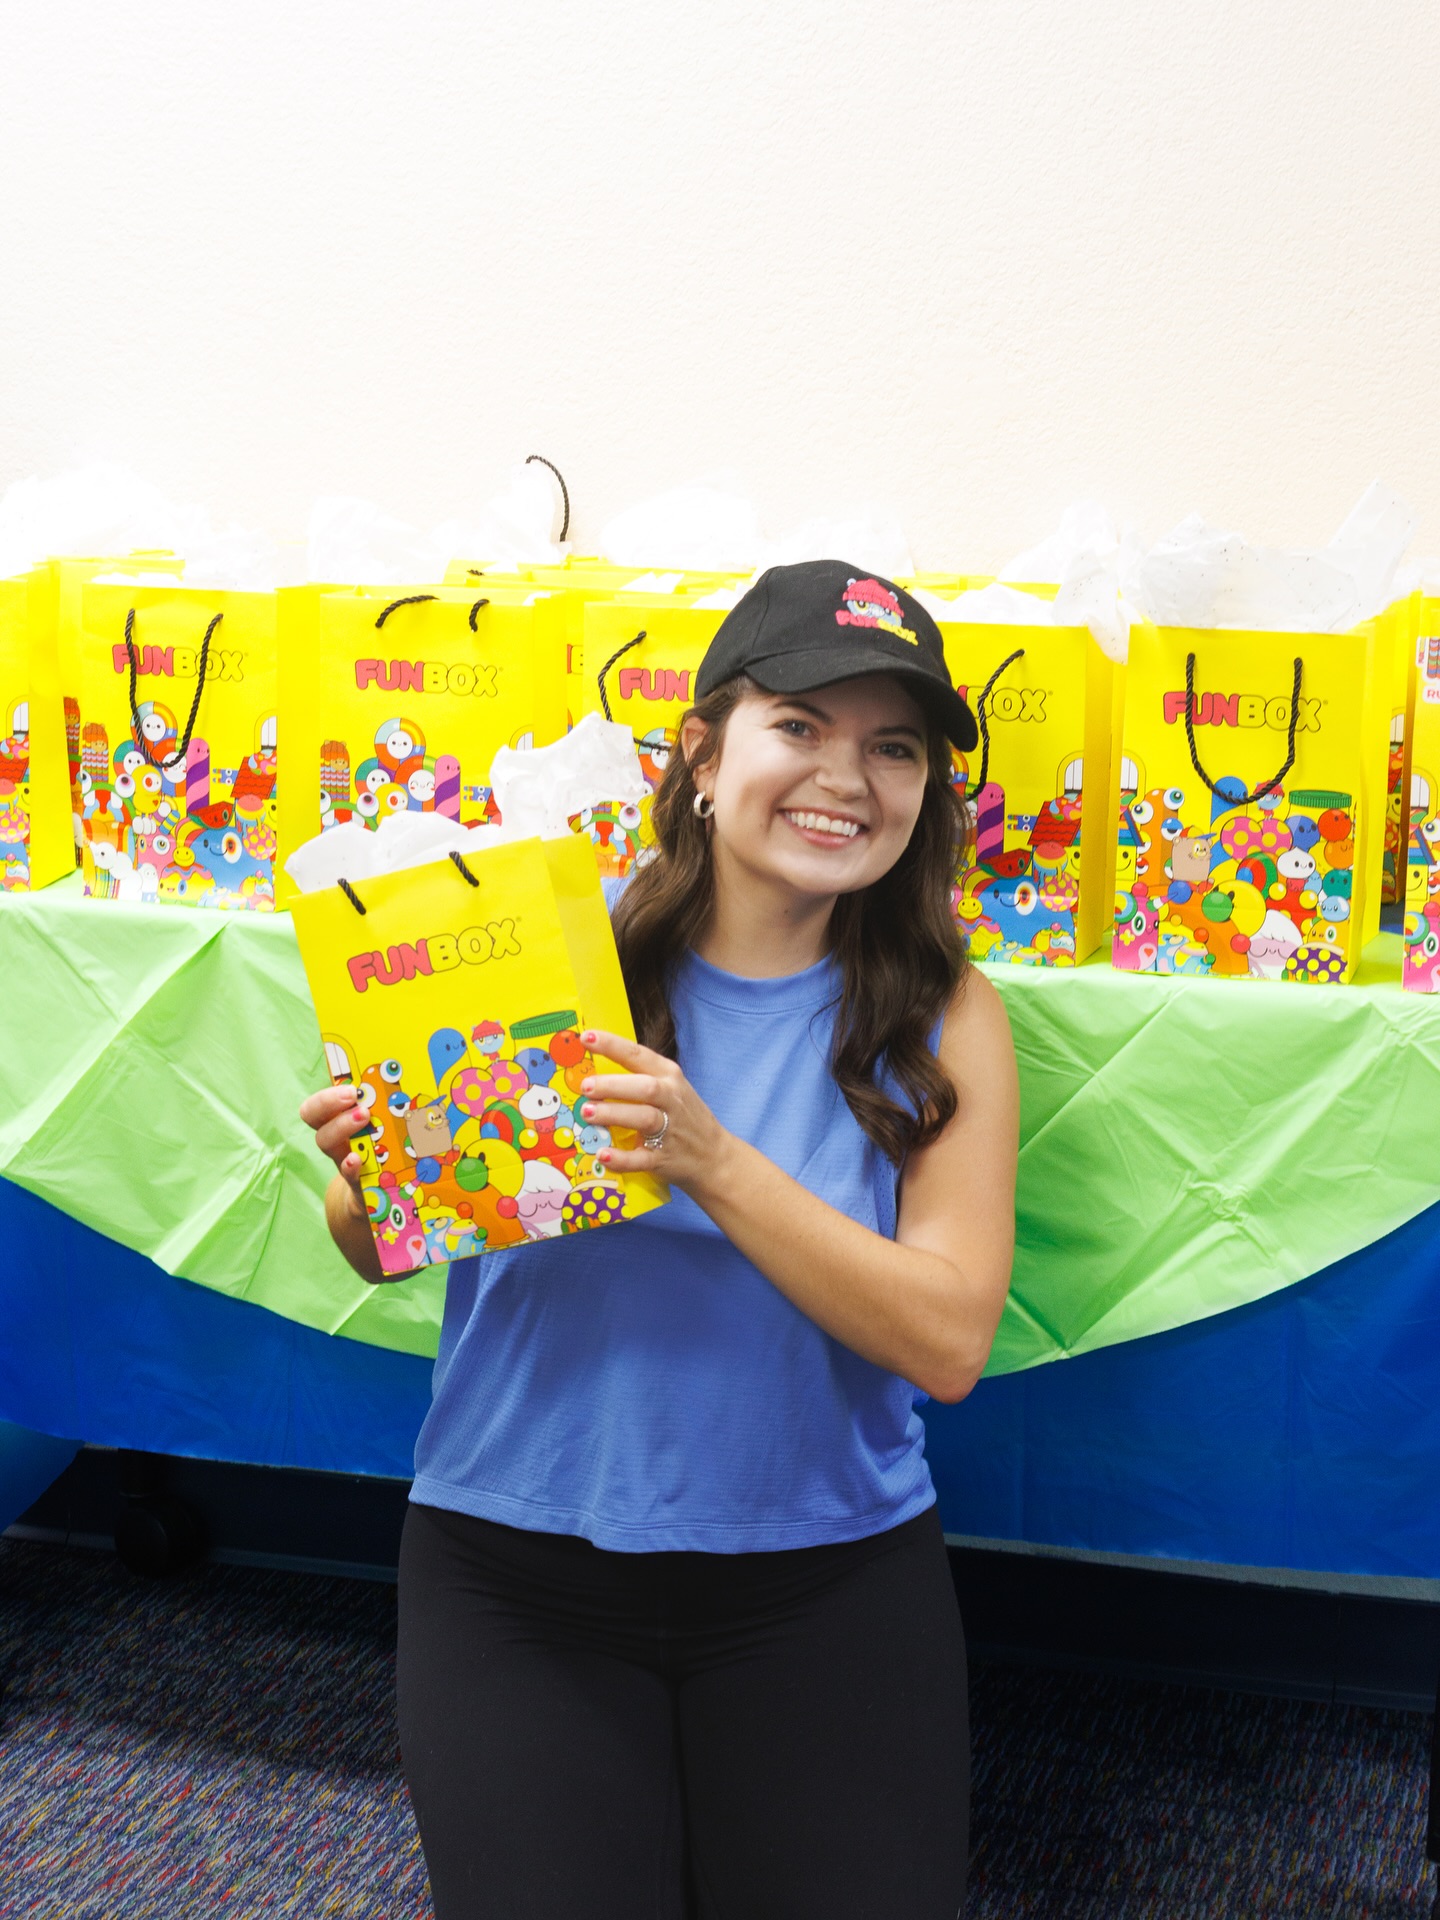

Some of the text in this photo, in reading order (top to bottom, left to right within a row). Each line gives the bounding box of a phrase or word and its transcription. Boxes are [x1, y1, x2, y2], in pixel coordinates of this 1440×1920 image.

[112, 643, 244, 682] FUNBOX
[354, 658, 498, 698] FUNBOX
[619, 667, 697, 702] FUN
[1163, 691, 1322, 733] FUNBOX
[346, 917, 522, 993] FUNBOX
